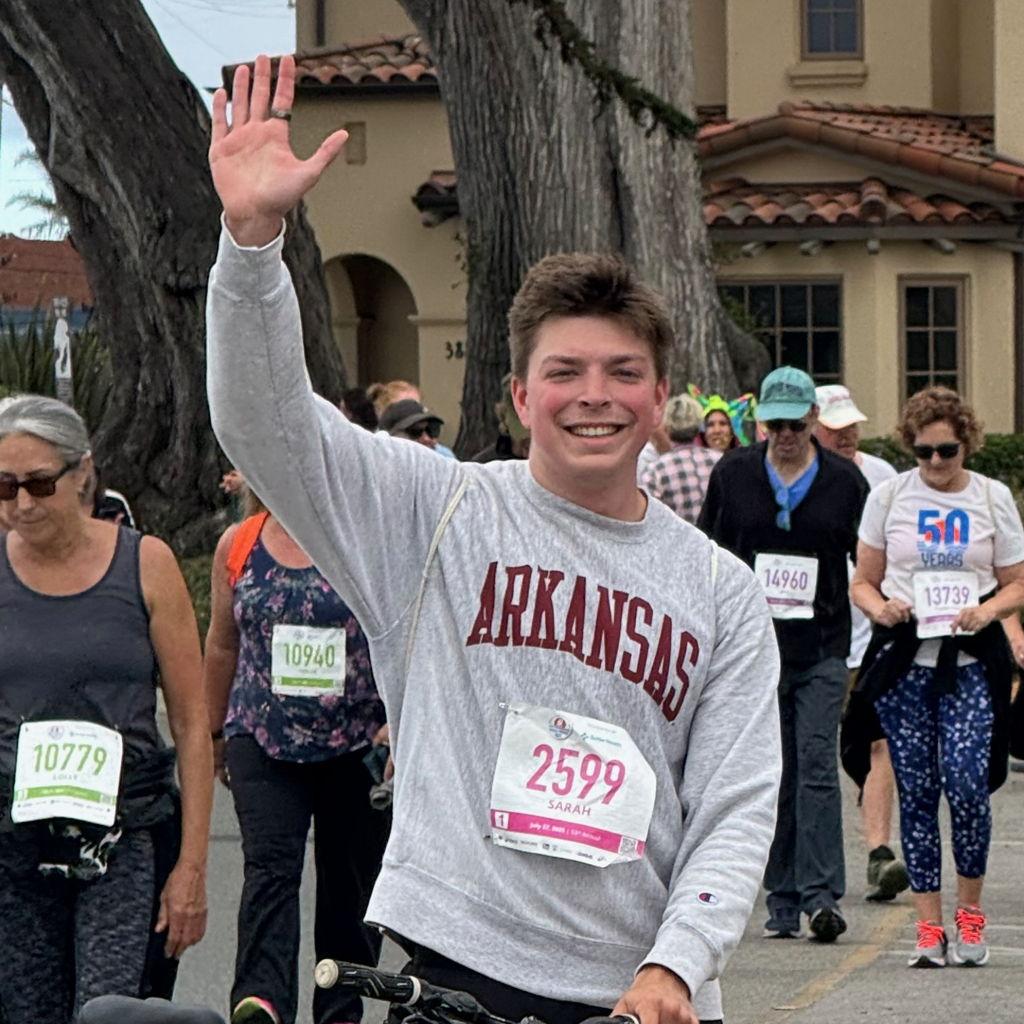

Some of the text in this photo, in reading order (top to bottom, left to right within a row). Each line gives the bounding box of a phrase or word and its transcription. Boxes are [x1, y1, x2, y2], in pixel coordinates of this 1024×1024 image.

[918, 508, 970, 545] 50
[764, 568, 808, 591] 14960
[924, 585, 971, 607] 13739
[283, 642, 335, 668] 10940
[466, 561, 701, 722] ARKANSAS
[33, 743, 107, 776] 10779
[526, 743, 626, 806] 2599
[547, 799, 592, 817] SARAH
